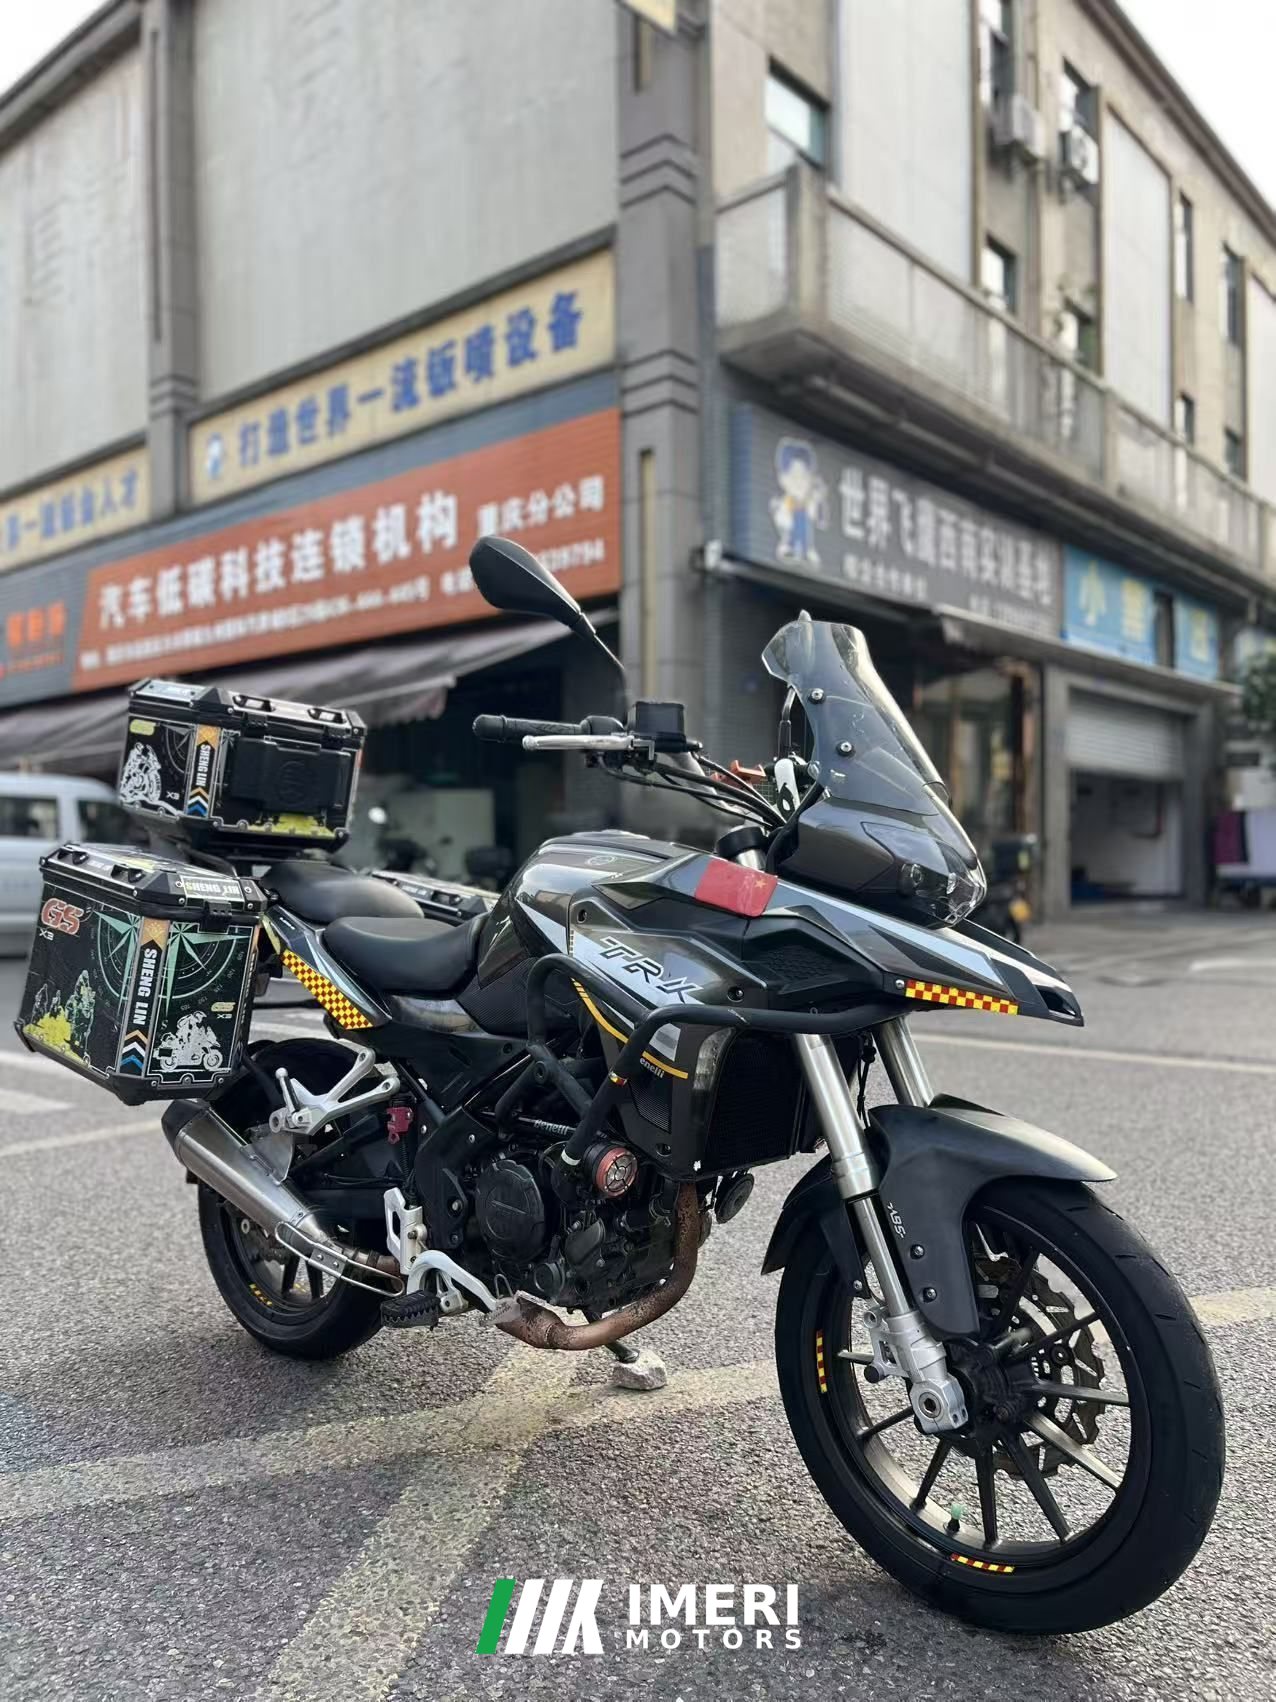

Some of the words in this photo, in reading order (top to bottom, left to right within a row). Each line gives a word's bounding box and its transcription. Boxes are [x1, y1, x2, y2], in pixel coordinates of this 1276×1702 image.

[100, 489, 458, 629] 汽车低碳科技连锁机构
[41, 897, 84, 936] GS
[137, 948, 158, 998] SHENG
[600, 936, 703, 1005] TRK
[132, 1001, 150, 1026] LIN
[639, 1057, 665, 1079] enelli
